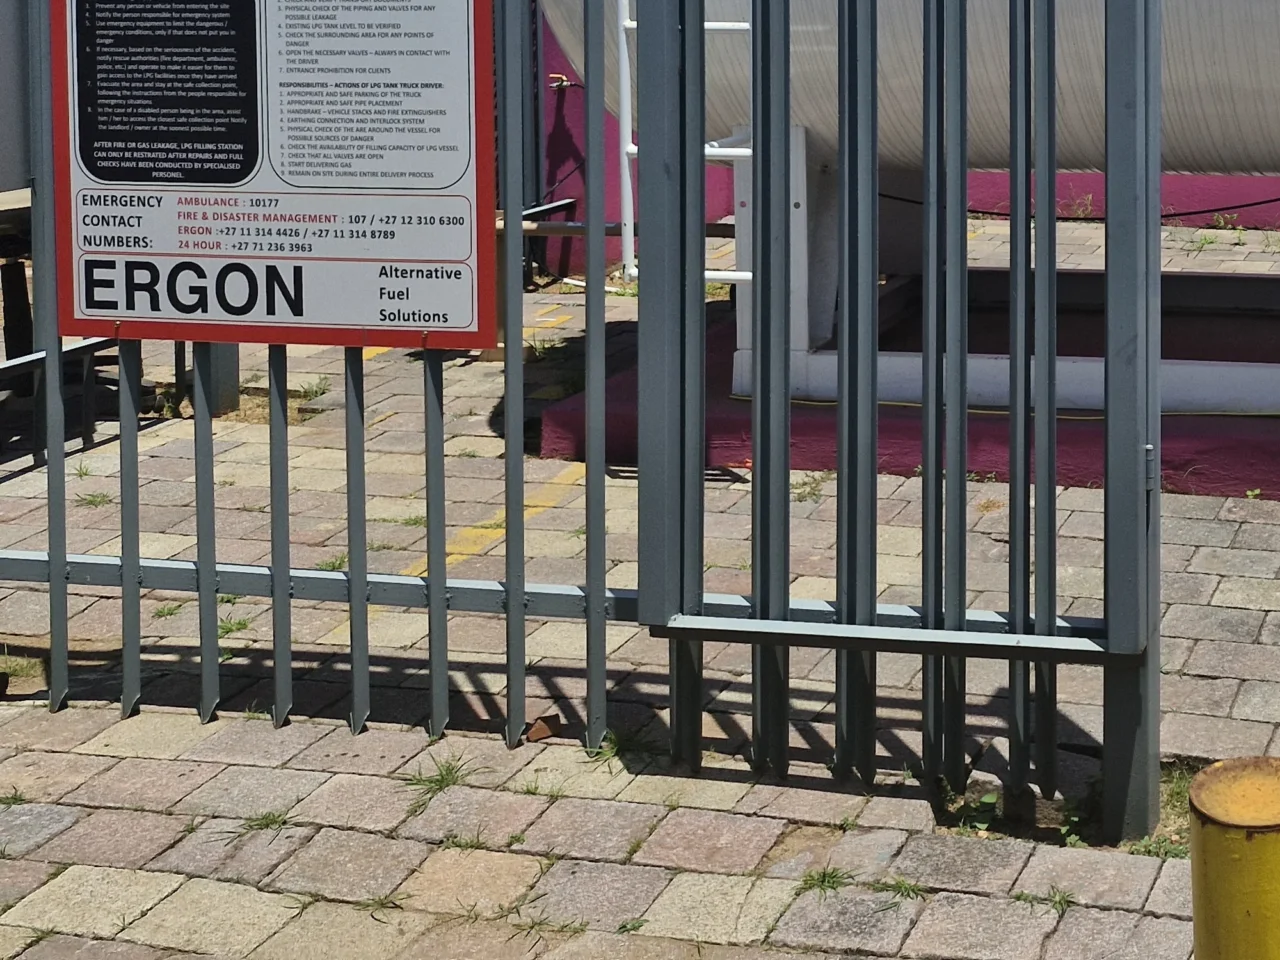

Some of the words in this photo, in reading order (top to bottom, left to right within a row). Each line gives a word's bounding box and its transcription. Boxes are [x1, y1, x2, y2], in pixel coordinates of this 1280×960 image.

[83, 194, 163, 208] EMERGENCY
[177, 197, 239, 207] AMBULANCE
[250, 198, 279, 208] 10177
[83, 215, 142, 228] CONTACT
[178, 212, 198, 220] FIRE
[202, 212, 208, 220] &
[213, 213, 259, 222] DISASTER
[263, 214, 338, 223] MANAGEMENT
[349, 215, 366, 224] 107
[370, 215, 375, 226] /
[379, 216, 397, 225] +27
[401, 216, 413, 225] 12
[417, 216, 435, 225] 310
[439, 216, 464, 226] 6300
[178, 226, 212, 235] ERGON
[241, 228, 251, 236] 11
[255, 228, 272, 237] 314
[276, 228, 300, 237] 4426
[303, 228, 308, 239] /
[312, 229, 330, 238] +27
[334, 230, 345, 238] 11
[349, 230, 367, 239] 314
[371, 230, 395, 239] 8789
[83, 234, 153, 248] NUMBERS:
[179, 240, 189, 249] 24
[193, 241, 221, 250] HOUR
[232, 242, 249, 251] +27
[252, 242, 264, 251] 71
[268, 243, 285, 252] 236
[289, 243, 312, 252] 3963
[379, 265, 462, 280] Alternative
[84, 259, 304, 316] ERGON
[380, 287, 409, 300] Fuel
[379, 308, 448, 324] Solutions
